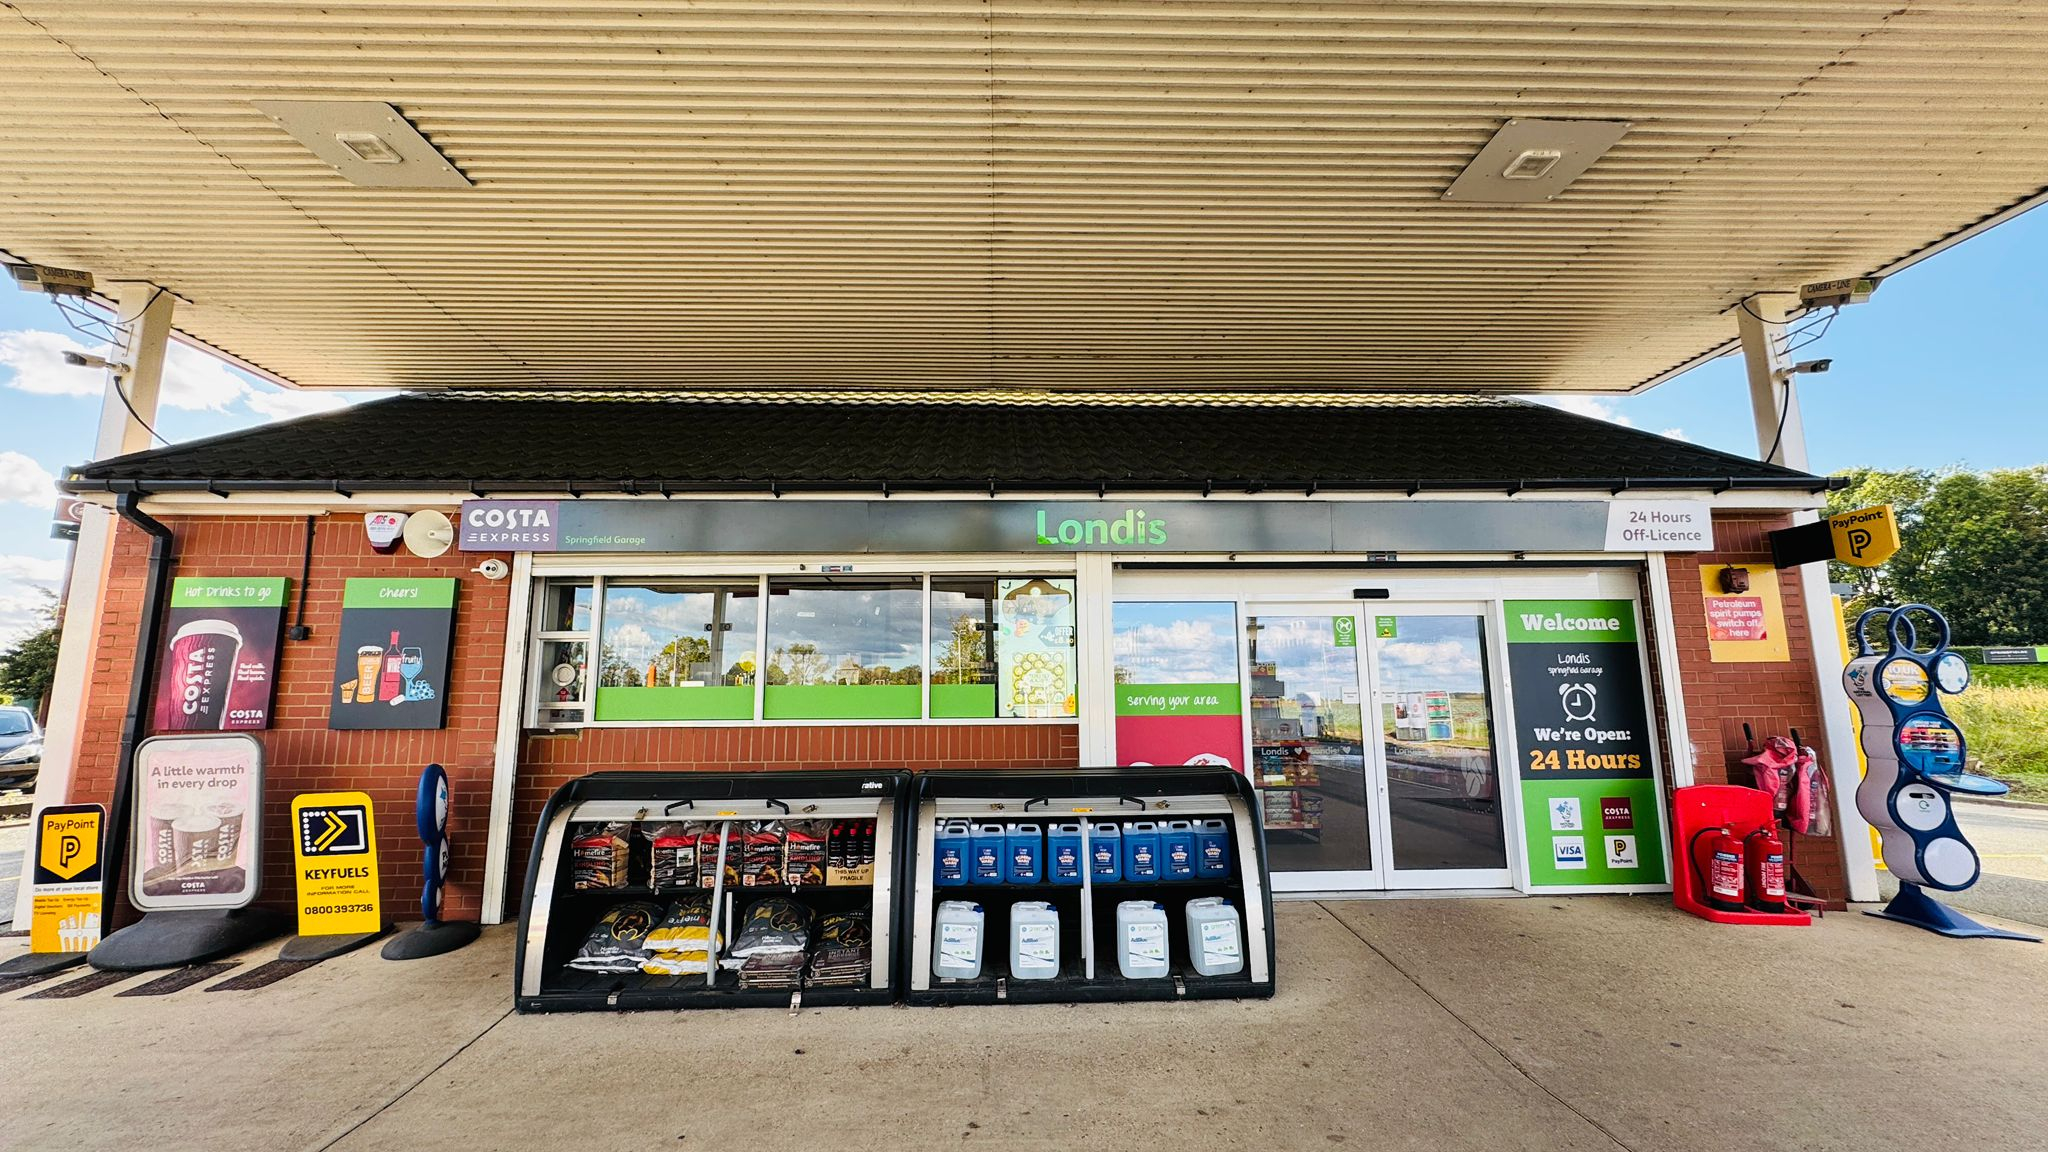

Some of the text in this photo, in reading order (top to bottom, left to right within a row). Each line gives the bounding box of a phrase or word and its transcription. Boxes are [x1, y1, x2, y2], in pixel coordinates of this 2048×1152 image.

[468, 508, 550, 530] COSTA
[1629, 511, 1692, 523] 24 Hours
[1832, 511, 1883, 529] PayPoint
[1036, 509, 1167, 545] Londis
[480, 533, 550, 542] EXPRESS
[565, 535, 646, 545] Springfield Garage
[1623, 529, 1702, 541] Off-Licence
[184, 586, 272, 601] Hot Drinks to go
[379, 587, 418, 598] Cheers!
[1712, 600, 1756, 608] Petroleum
[1710, 610, 1731, 618] spirit
[1520, 613, 1620, 631] Welcome
[1716, 619, 1745, 627] switch
[1729, 629, 1750, 637] here
[1557, 653, 1591, 664] Londis
[183, 648, 204, 715] COSTA
[202, 647, 216, 703] EXPRESS
[362, 665, 375, 694] BEER
[1127, 695, 1219, 710] serving your area
[230, 710, 263, 719] COSTA
[1533, 727, 1632, 743] We're Open:
[1261, 747, 1290, 756] Londis
[1530, 750, 1641, 770] 24 Hours
[151, 764, 244, 777] A little warmth
[157, 778, 237, 790] in every drop
[47, 819, 96, 832] PayPoint
[159, 829, 168, 864] COSTA
[217, 824, 230, 861] COSTA
[1560, 846, 1581, 855] VISA
[305, 867, 369, 880] KEYFUELS
[304, 904, 373, 915] 0800 393736
